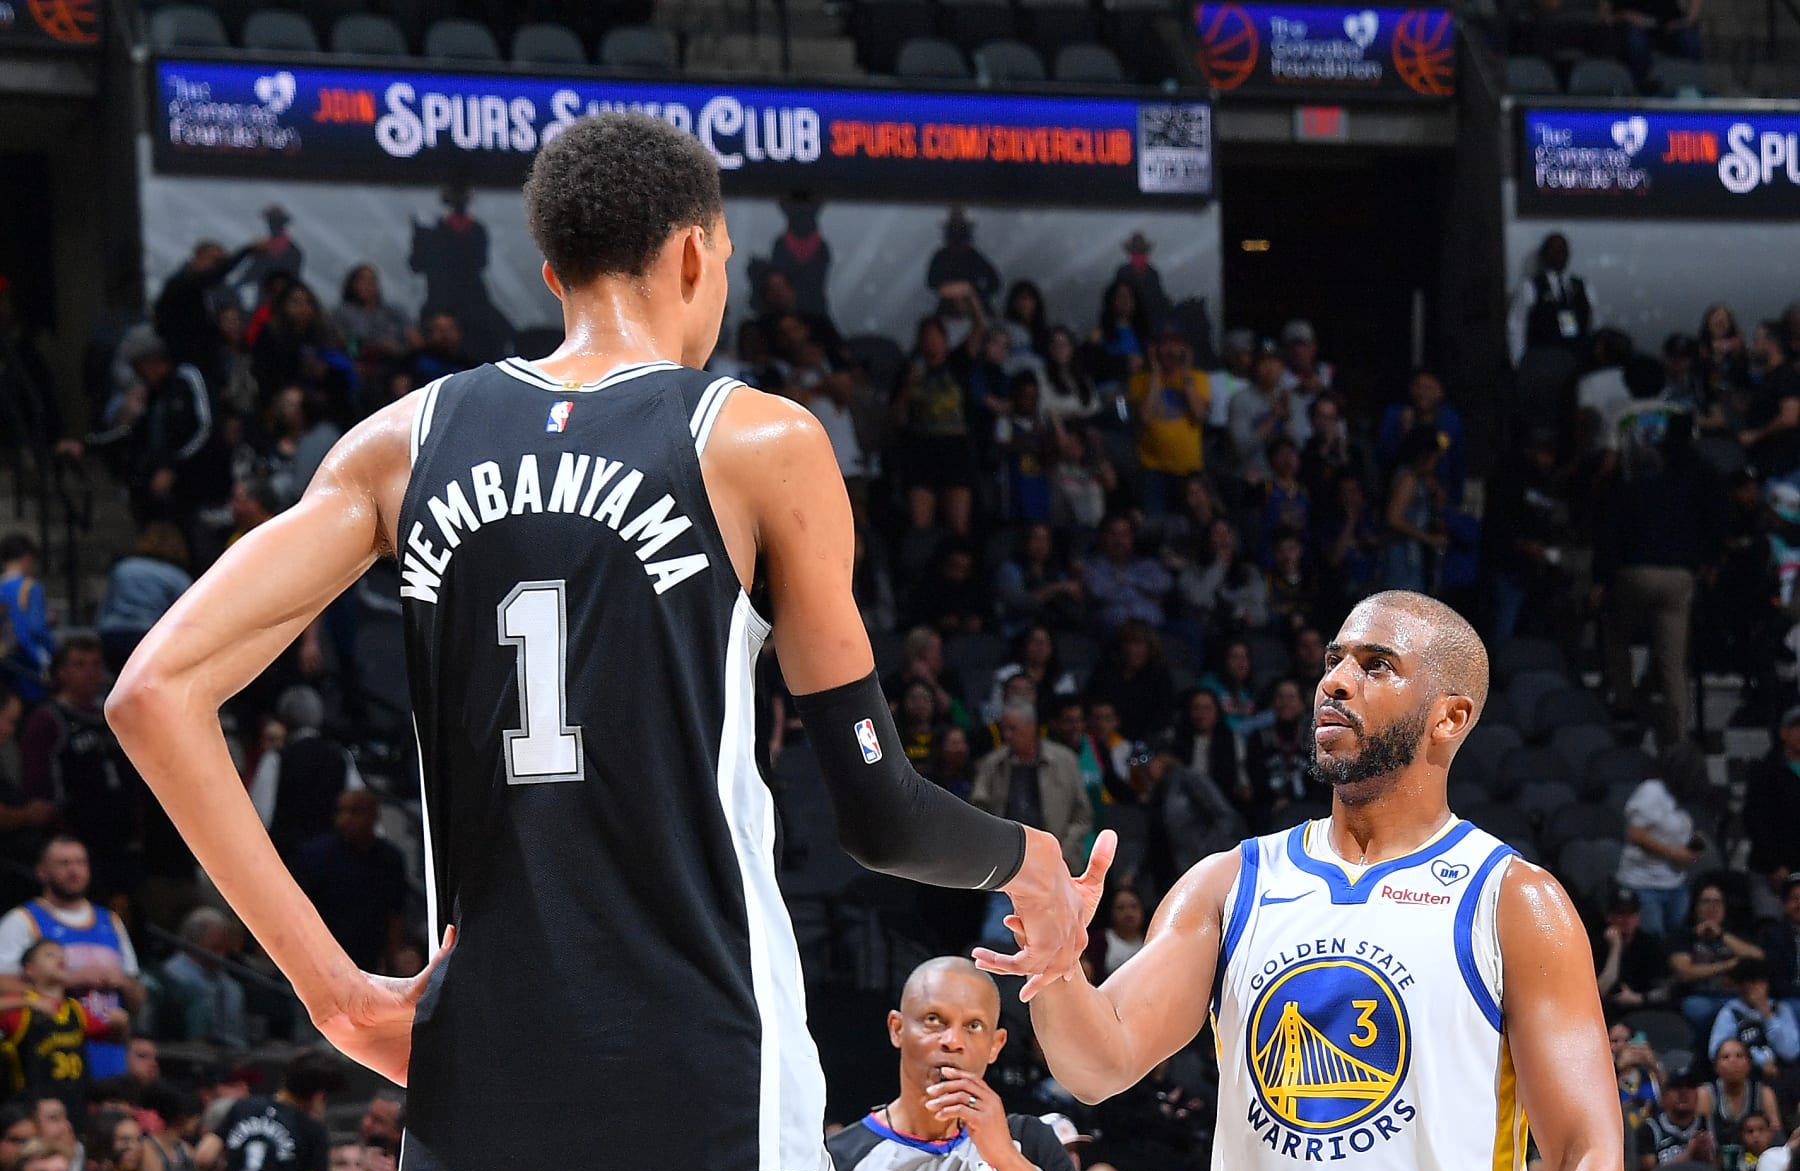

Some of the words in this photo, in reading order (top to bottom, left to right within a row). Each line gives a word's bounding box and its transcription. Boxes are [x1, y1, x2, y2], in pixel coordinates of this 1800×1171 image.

[313, 88, 376, 124] JOIN
[700, 96, 821, 170] CLUB
[1663, 130, 1718, 165] JOIN
[400, 452, 711, 604] WEMBANYAMA
[497, 579, 585, 785] 1
[1381, 885, 1451, 905] Rakuten
[1250, 938, 1346, 991] GOLDEN
[1355, 941, 1415, 991] STATE
[1349, 1000, 1378, 1048] 3
[1247, 1097, 1417, 1162] WARRIORS
